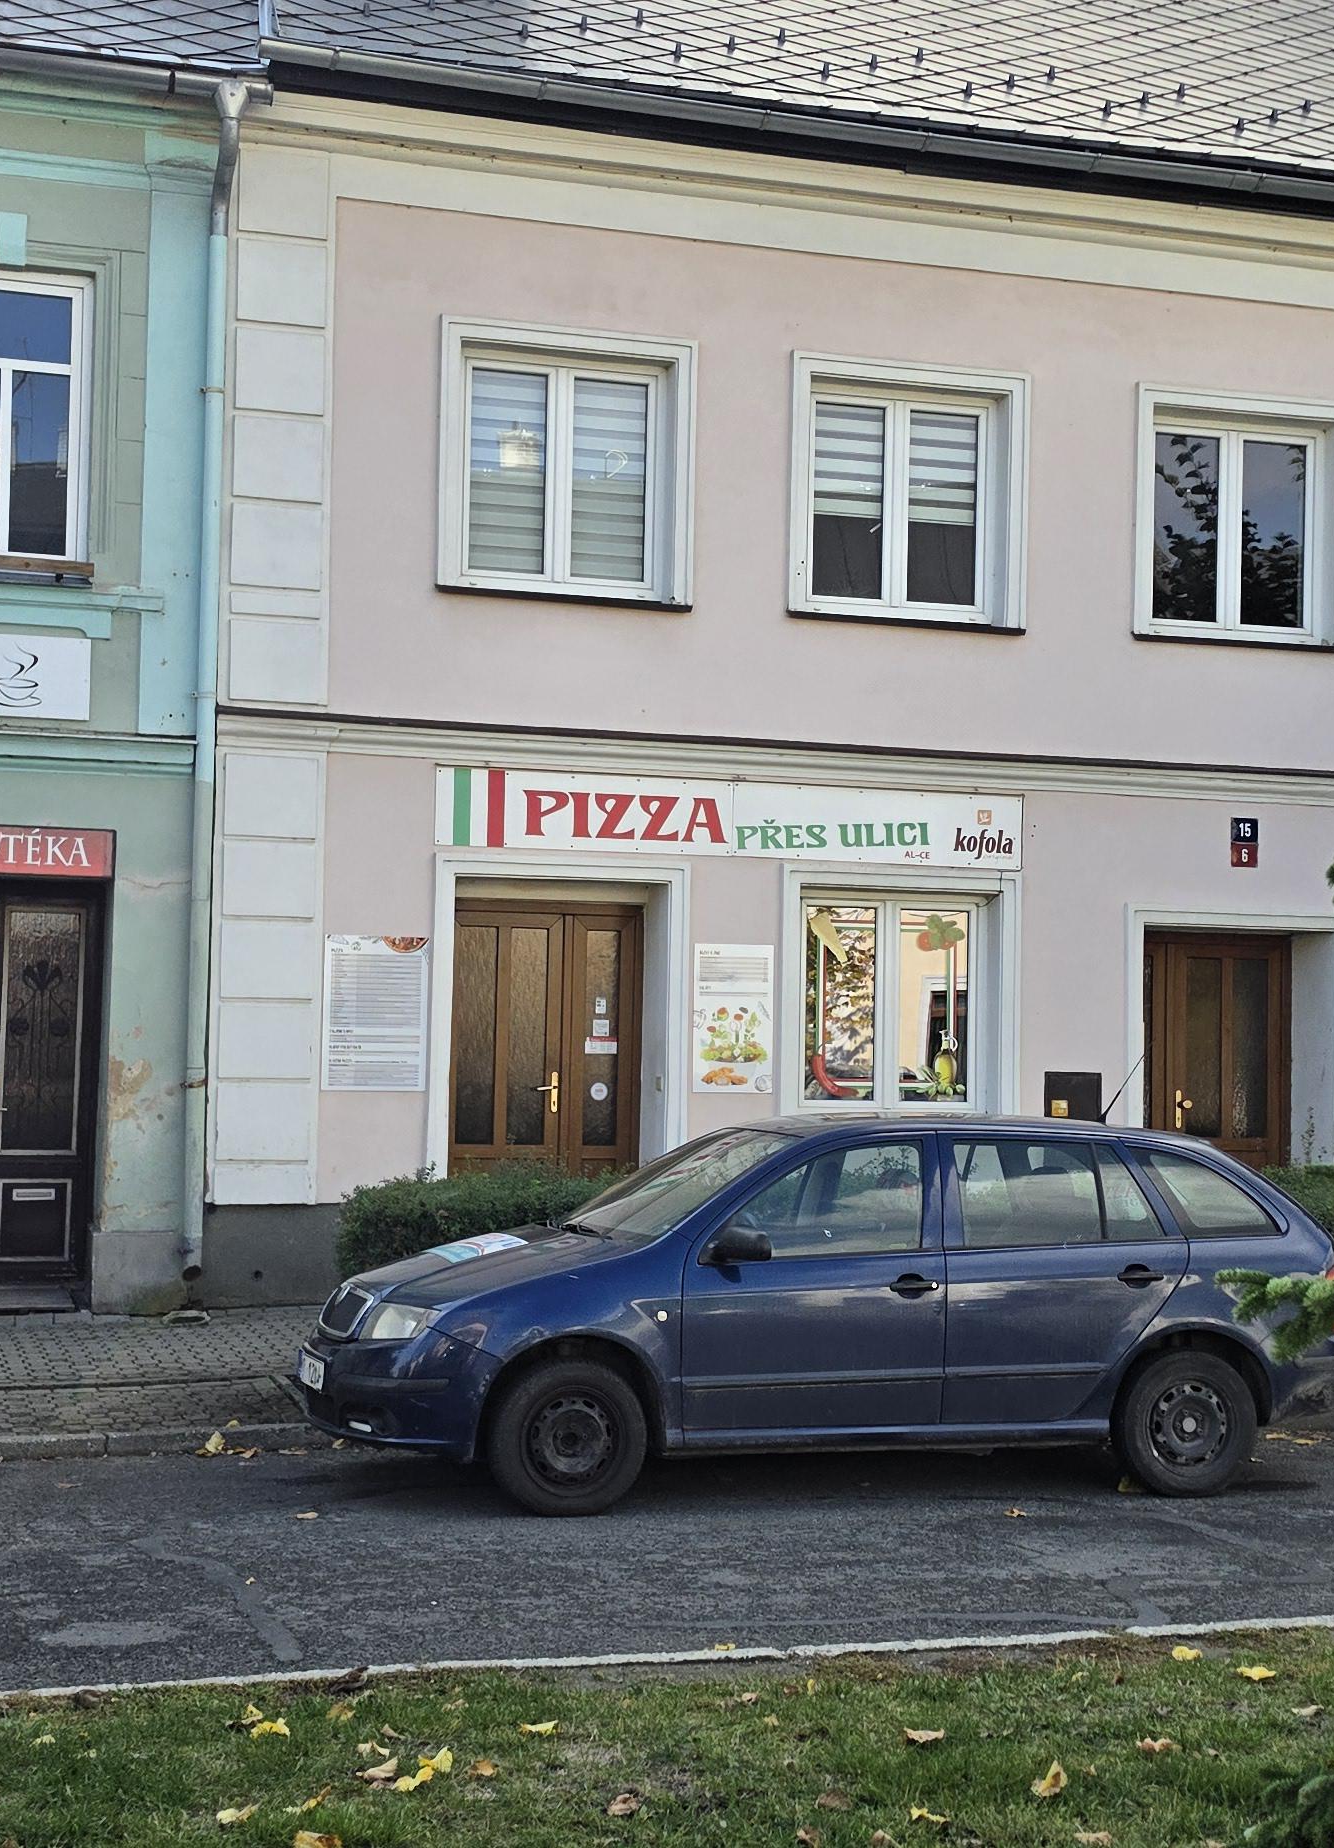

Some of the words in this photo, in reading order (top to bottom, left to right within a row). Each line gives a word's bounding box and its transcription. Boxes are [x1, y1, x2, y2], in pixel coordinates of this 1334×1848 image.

[523, 789, 729, 844] PIZZA
[735, 819, 828, 850] PŘES
[837, 822, 930, 847] ULICI
[1239, 822, 1252, 837] 15
[953, 827, 1014, 860] kofola
[1241, 848, 1249, 863] 6
